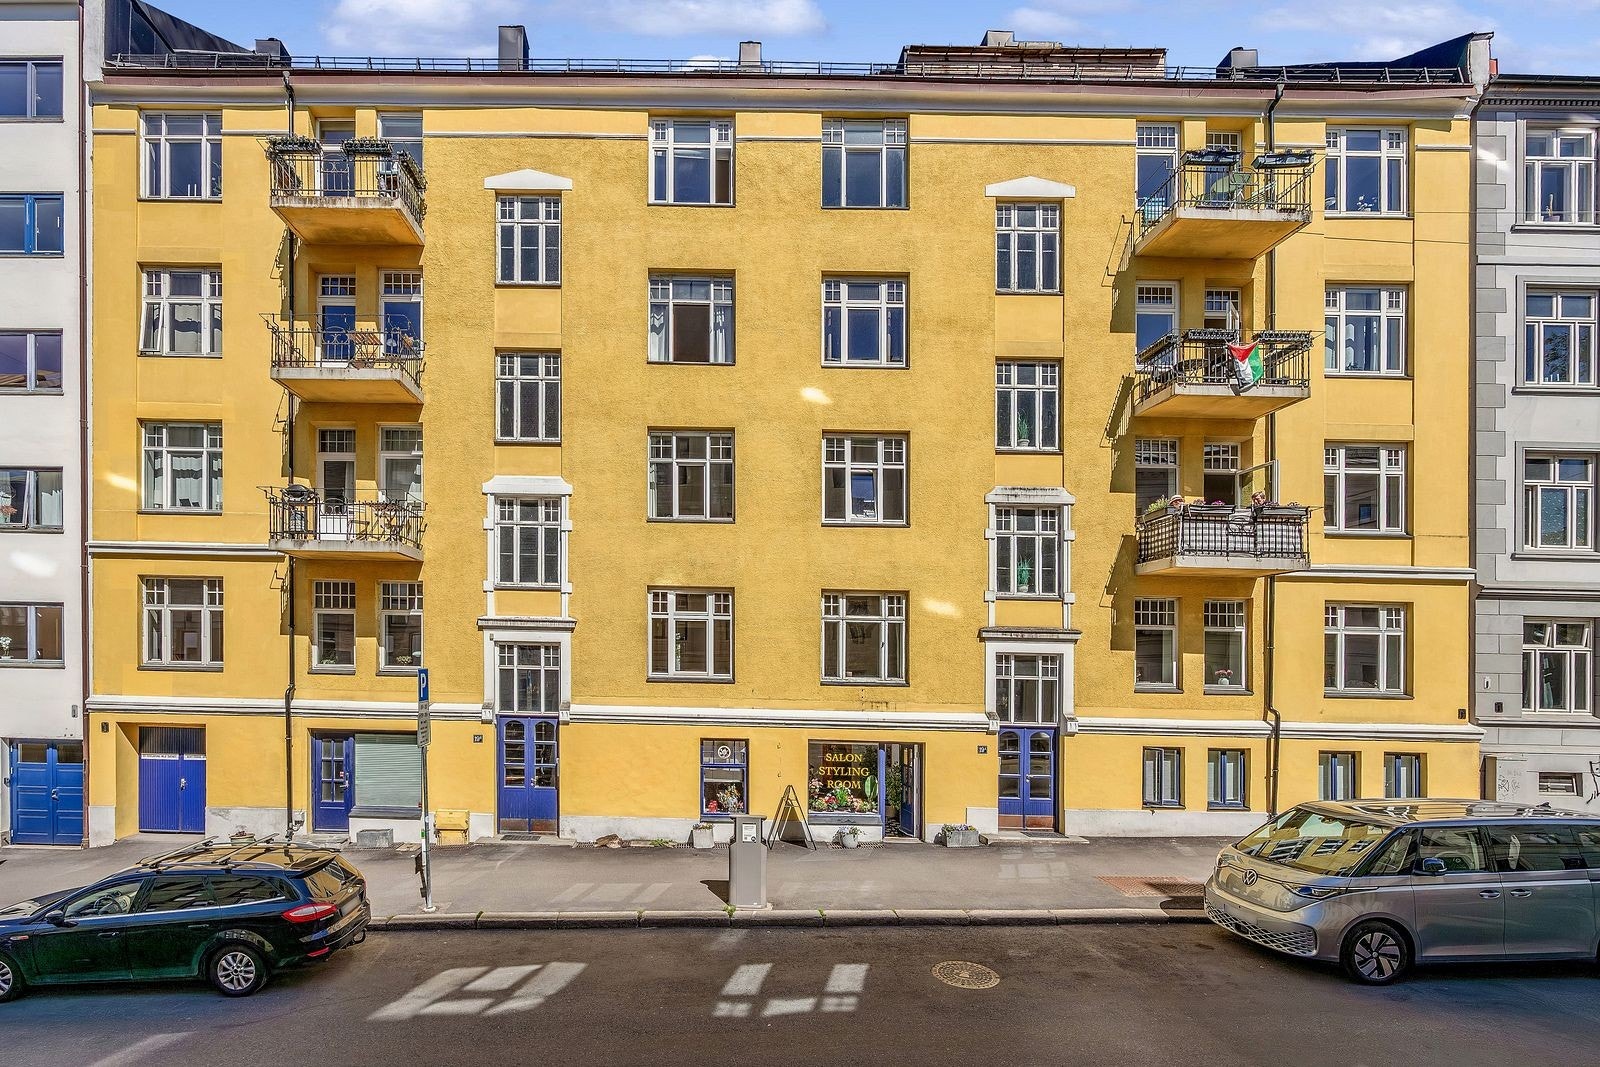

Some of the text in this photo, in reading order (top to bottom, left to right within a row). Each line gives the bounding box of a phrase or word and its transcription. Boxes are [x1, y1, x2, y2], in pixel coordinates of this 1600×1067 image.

[420, 673, 427, 698] P
[825, 753, 863, 763] SALON
[818, 766, 870, 777] STYLING
[827, 780, 862, 789] ROOM
